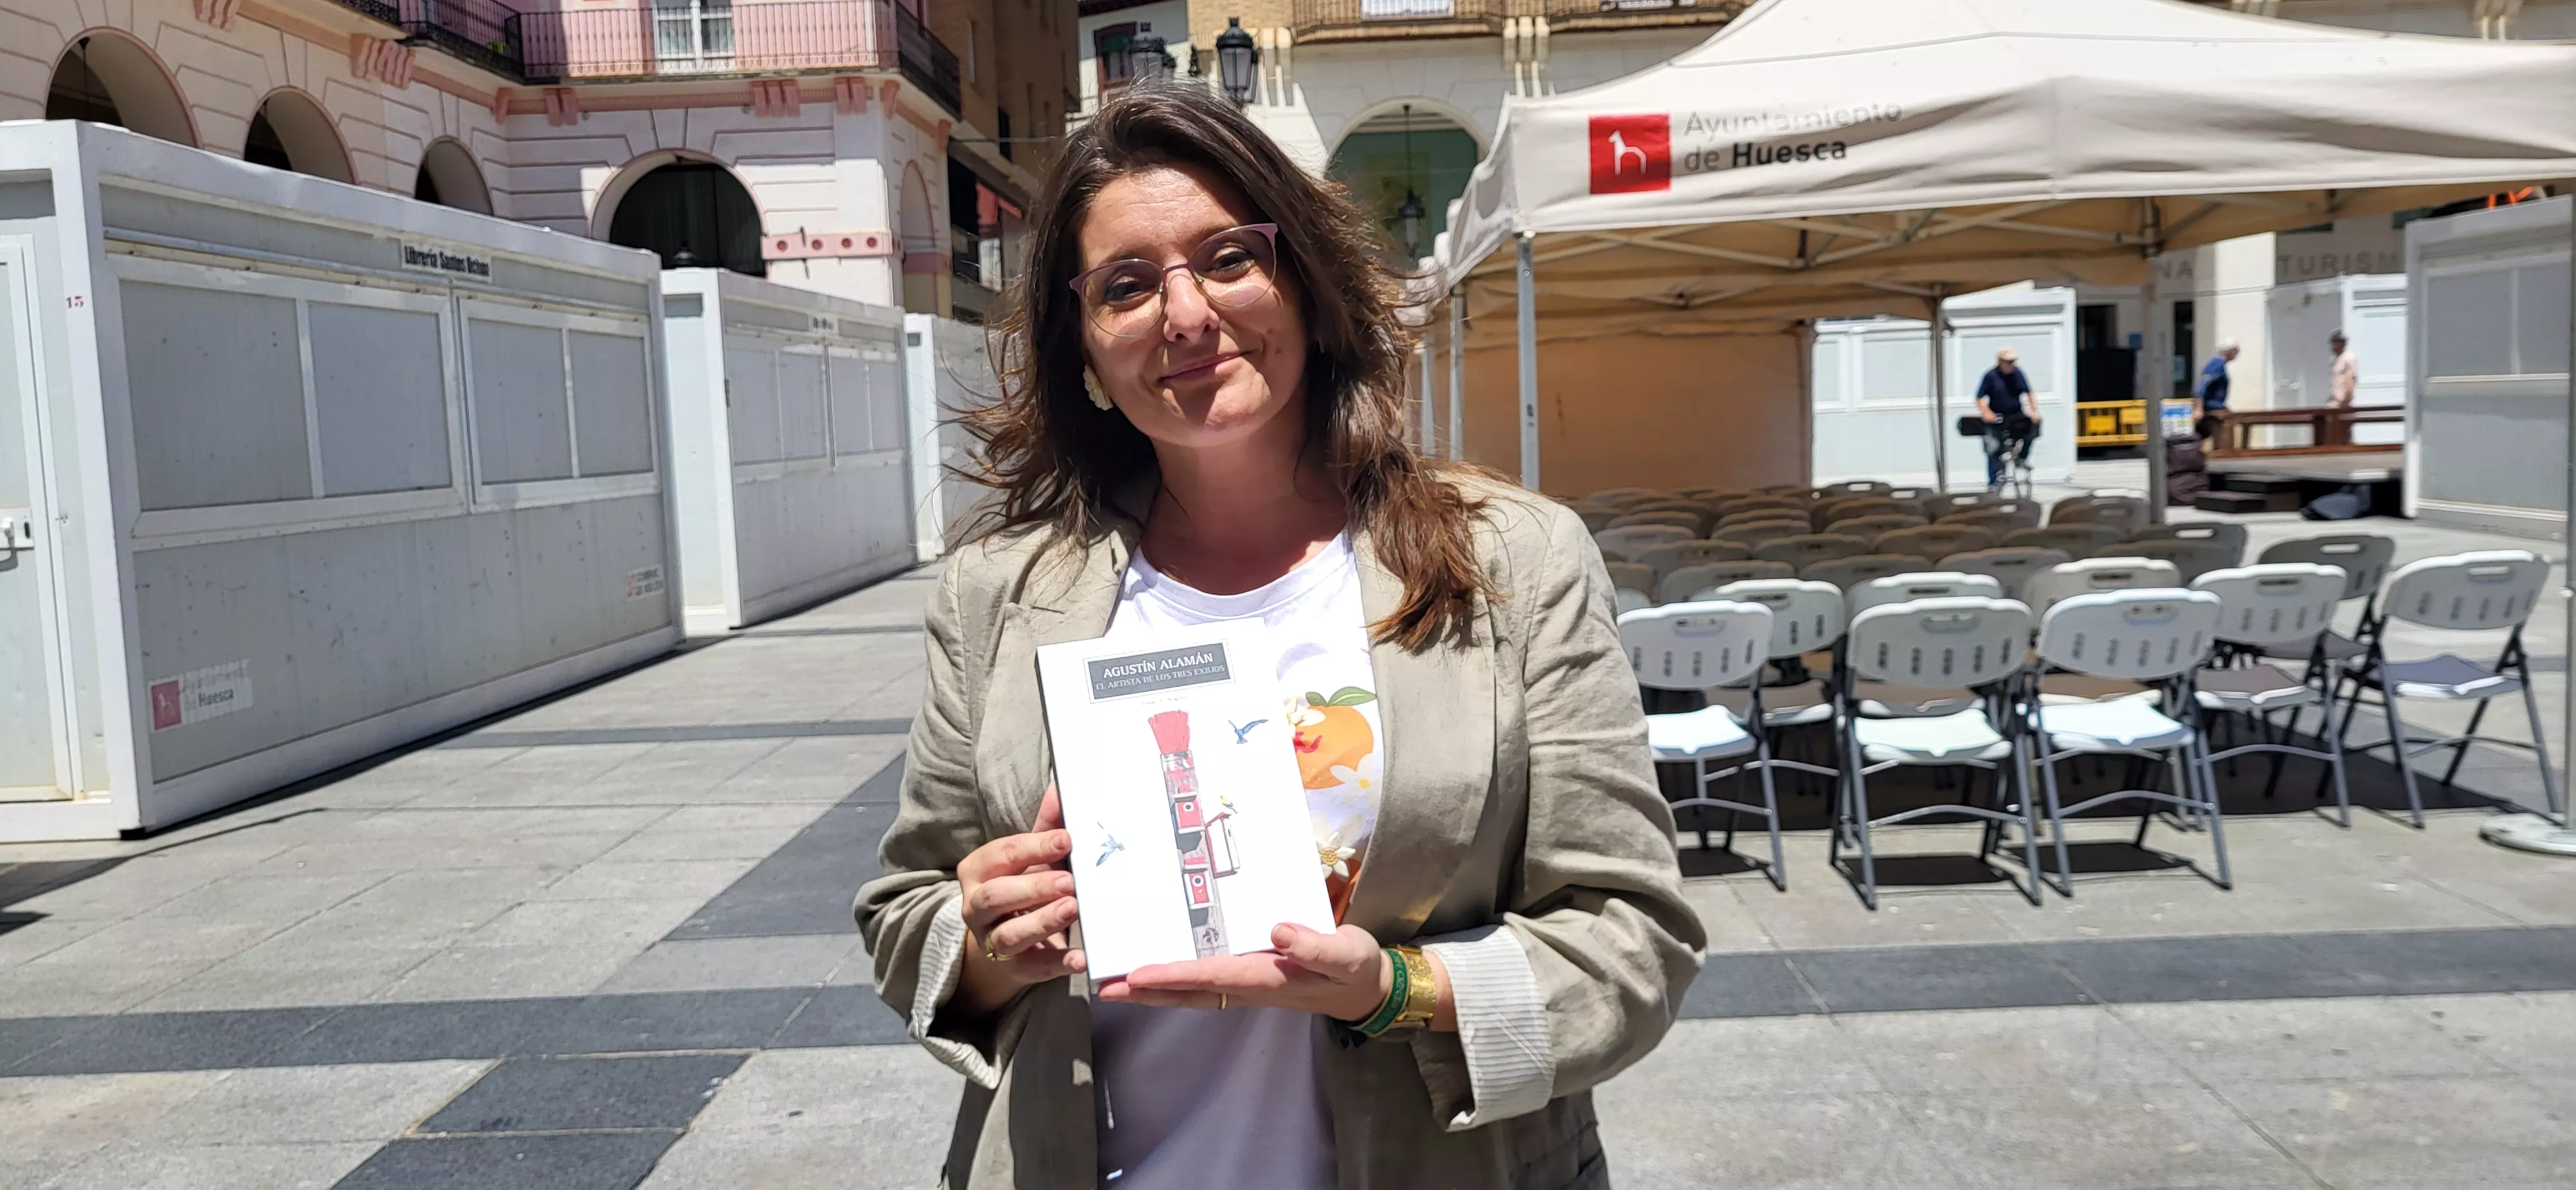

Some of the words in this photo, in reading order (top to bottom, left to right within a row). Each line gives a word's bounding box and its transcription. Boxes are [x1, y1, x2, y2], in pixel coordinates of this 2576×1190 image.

[1684, 103, 1902, 140] Ayuntamiento
[1685, 145, 1720, 171] de
[1732, 140, 1847, 167] Huesca
[1103, 660, 1157, 678] AGUSTÍN
[1160, 652, 1214, 670] ALAMÁN
[1108, 676, 1142, 690] ARTISTA
